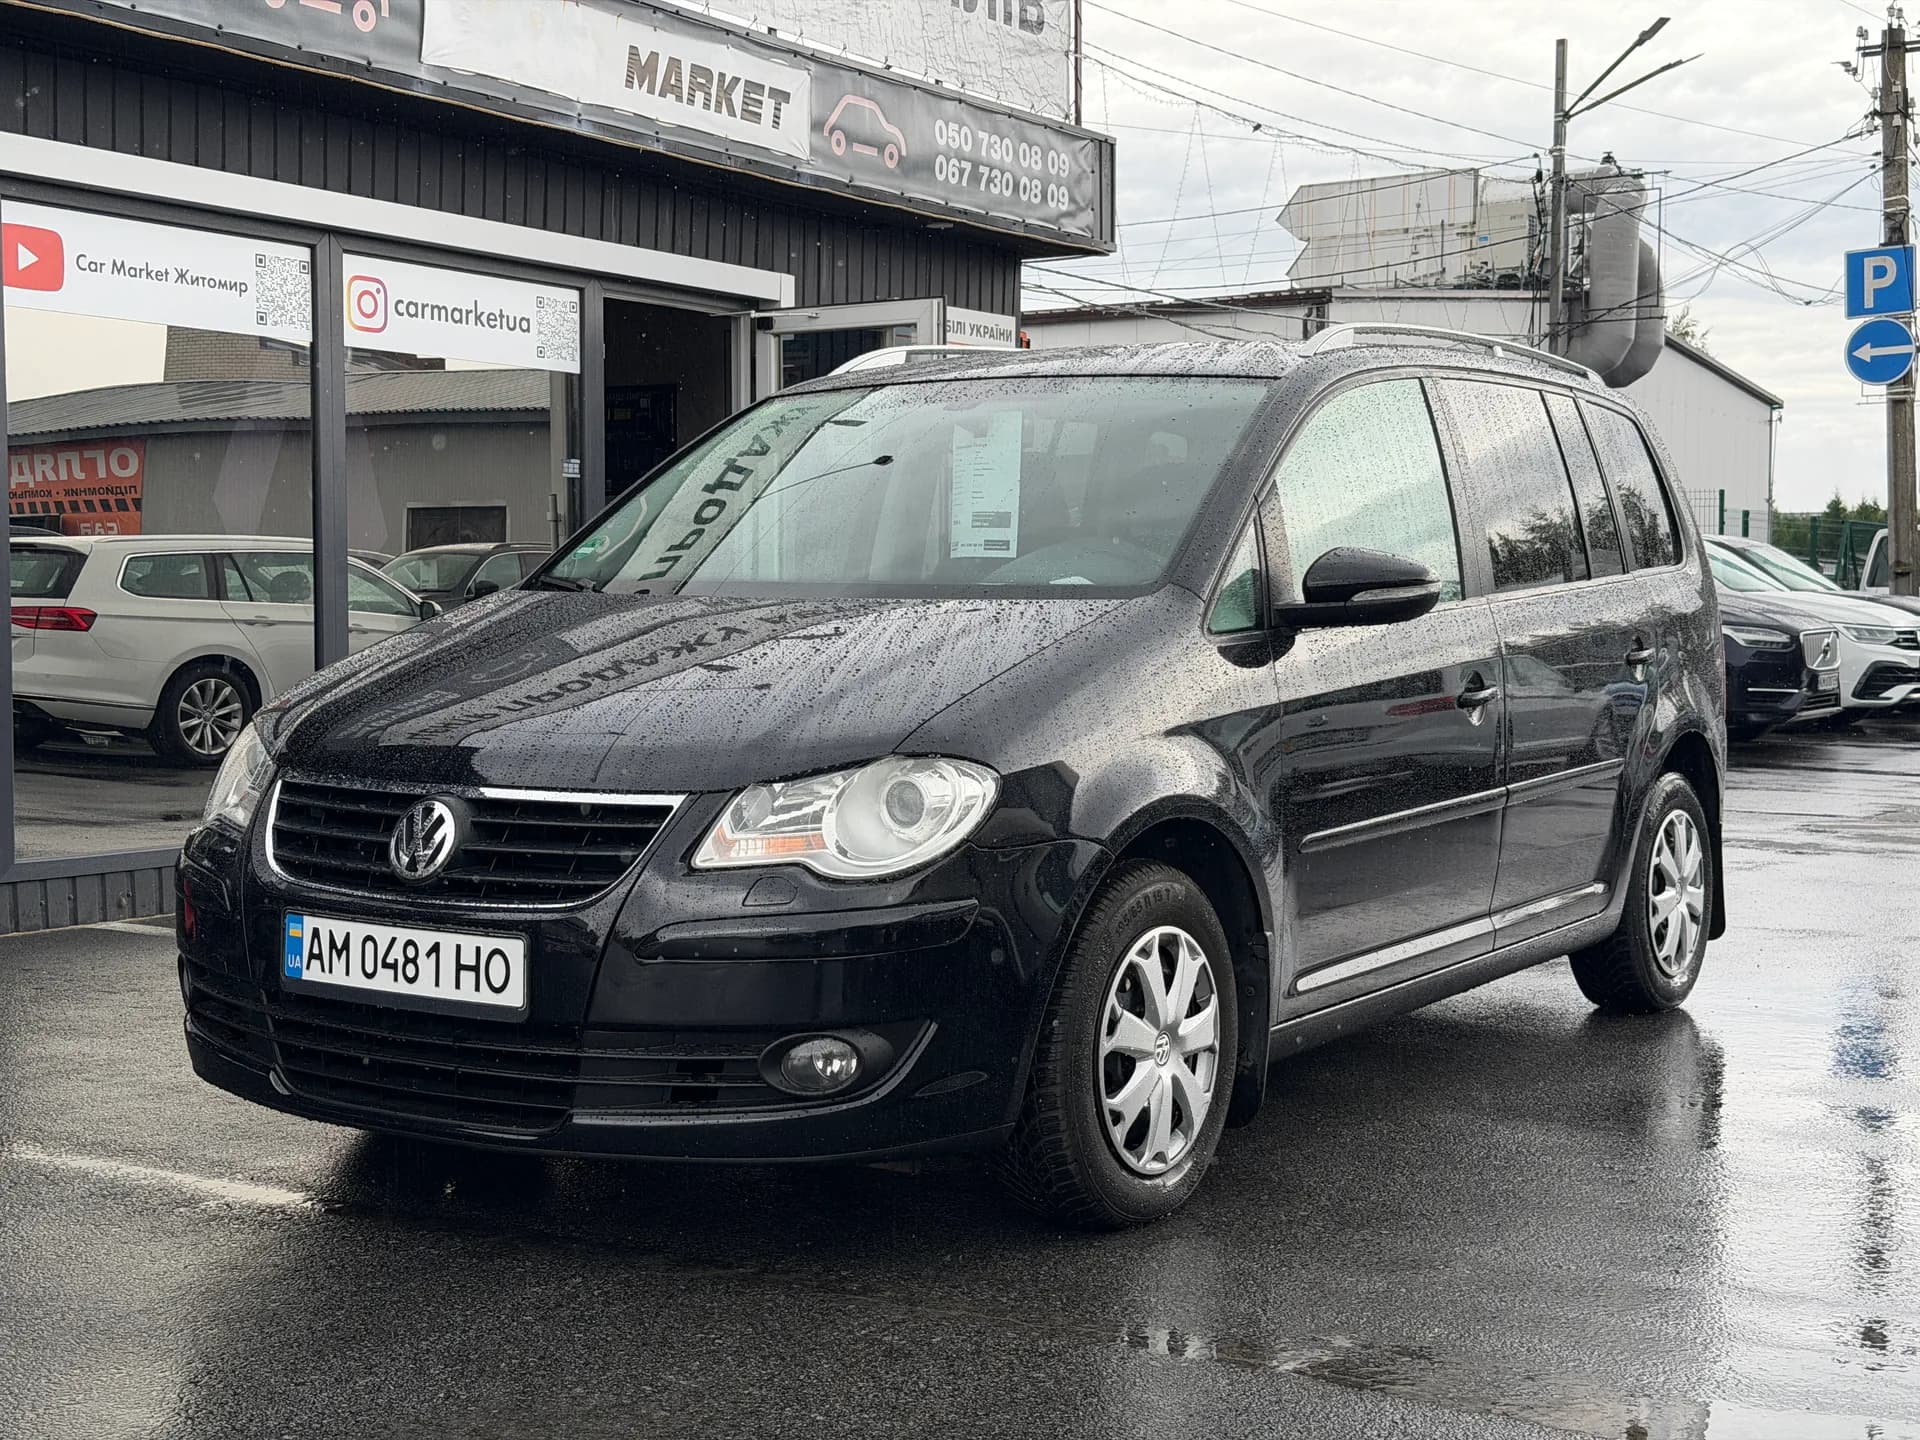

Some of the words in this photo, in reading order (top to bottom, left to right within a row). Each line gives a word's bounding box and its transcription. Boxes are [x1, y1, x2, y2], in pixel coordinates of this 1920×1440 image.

[624, 44, 791, 130] MARKET
[934, 119, 972, 152] 050
[978, 130, 1013, 163] 730
[1019, 142, 1042, 170] 08
[1048, 150, 1069, 178] 09
[935, 154, 972, 187] 067
[978, 165, 1013, 197] 730
[1019, 176, 1042, 204] 08
[1047, 183, 1069, 210] 09
[75, 253, 106, 274] Car
[111, 259, 169, 282] Market
[174, 267, 248, 297] Житомир
[1863, 255, 1897, 309] P
[394, 299, 531, 334] carmarketua
[969, 323, 1013, 343] УКРАЇНИ
[288, 954, 301, 968] UA
[306, 927, 350, 977] AM
[361, 934, 440, 988] 0481
[455, 943, 510, 994] HO
